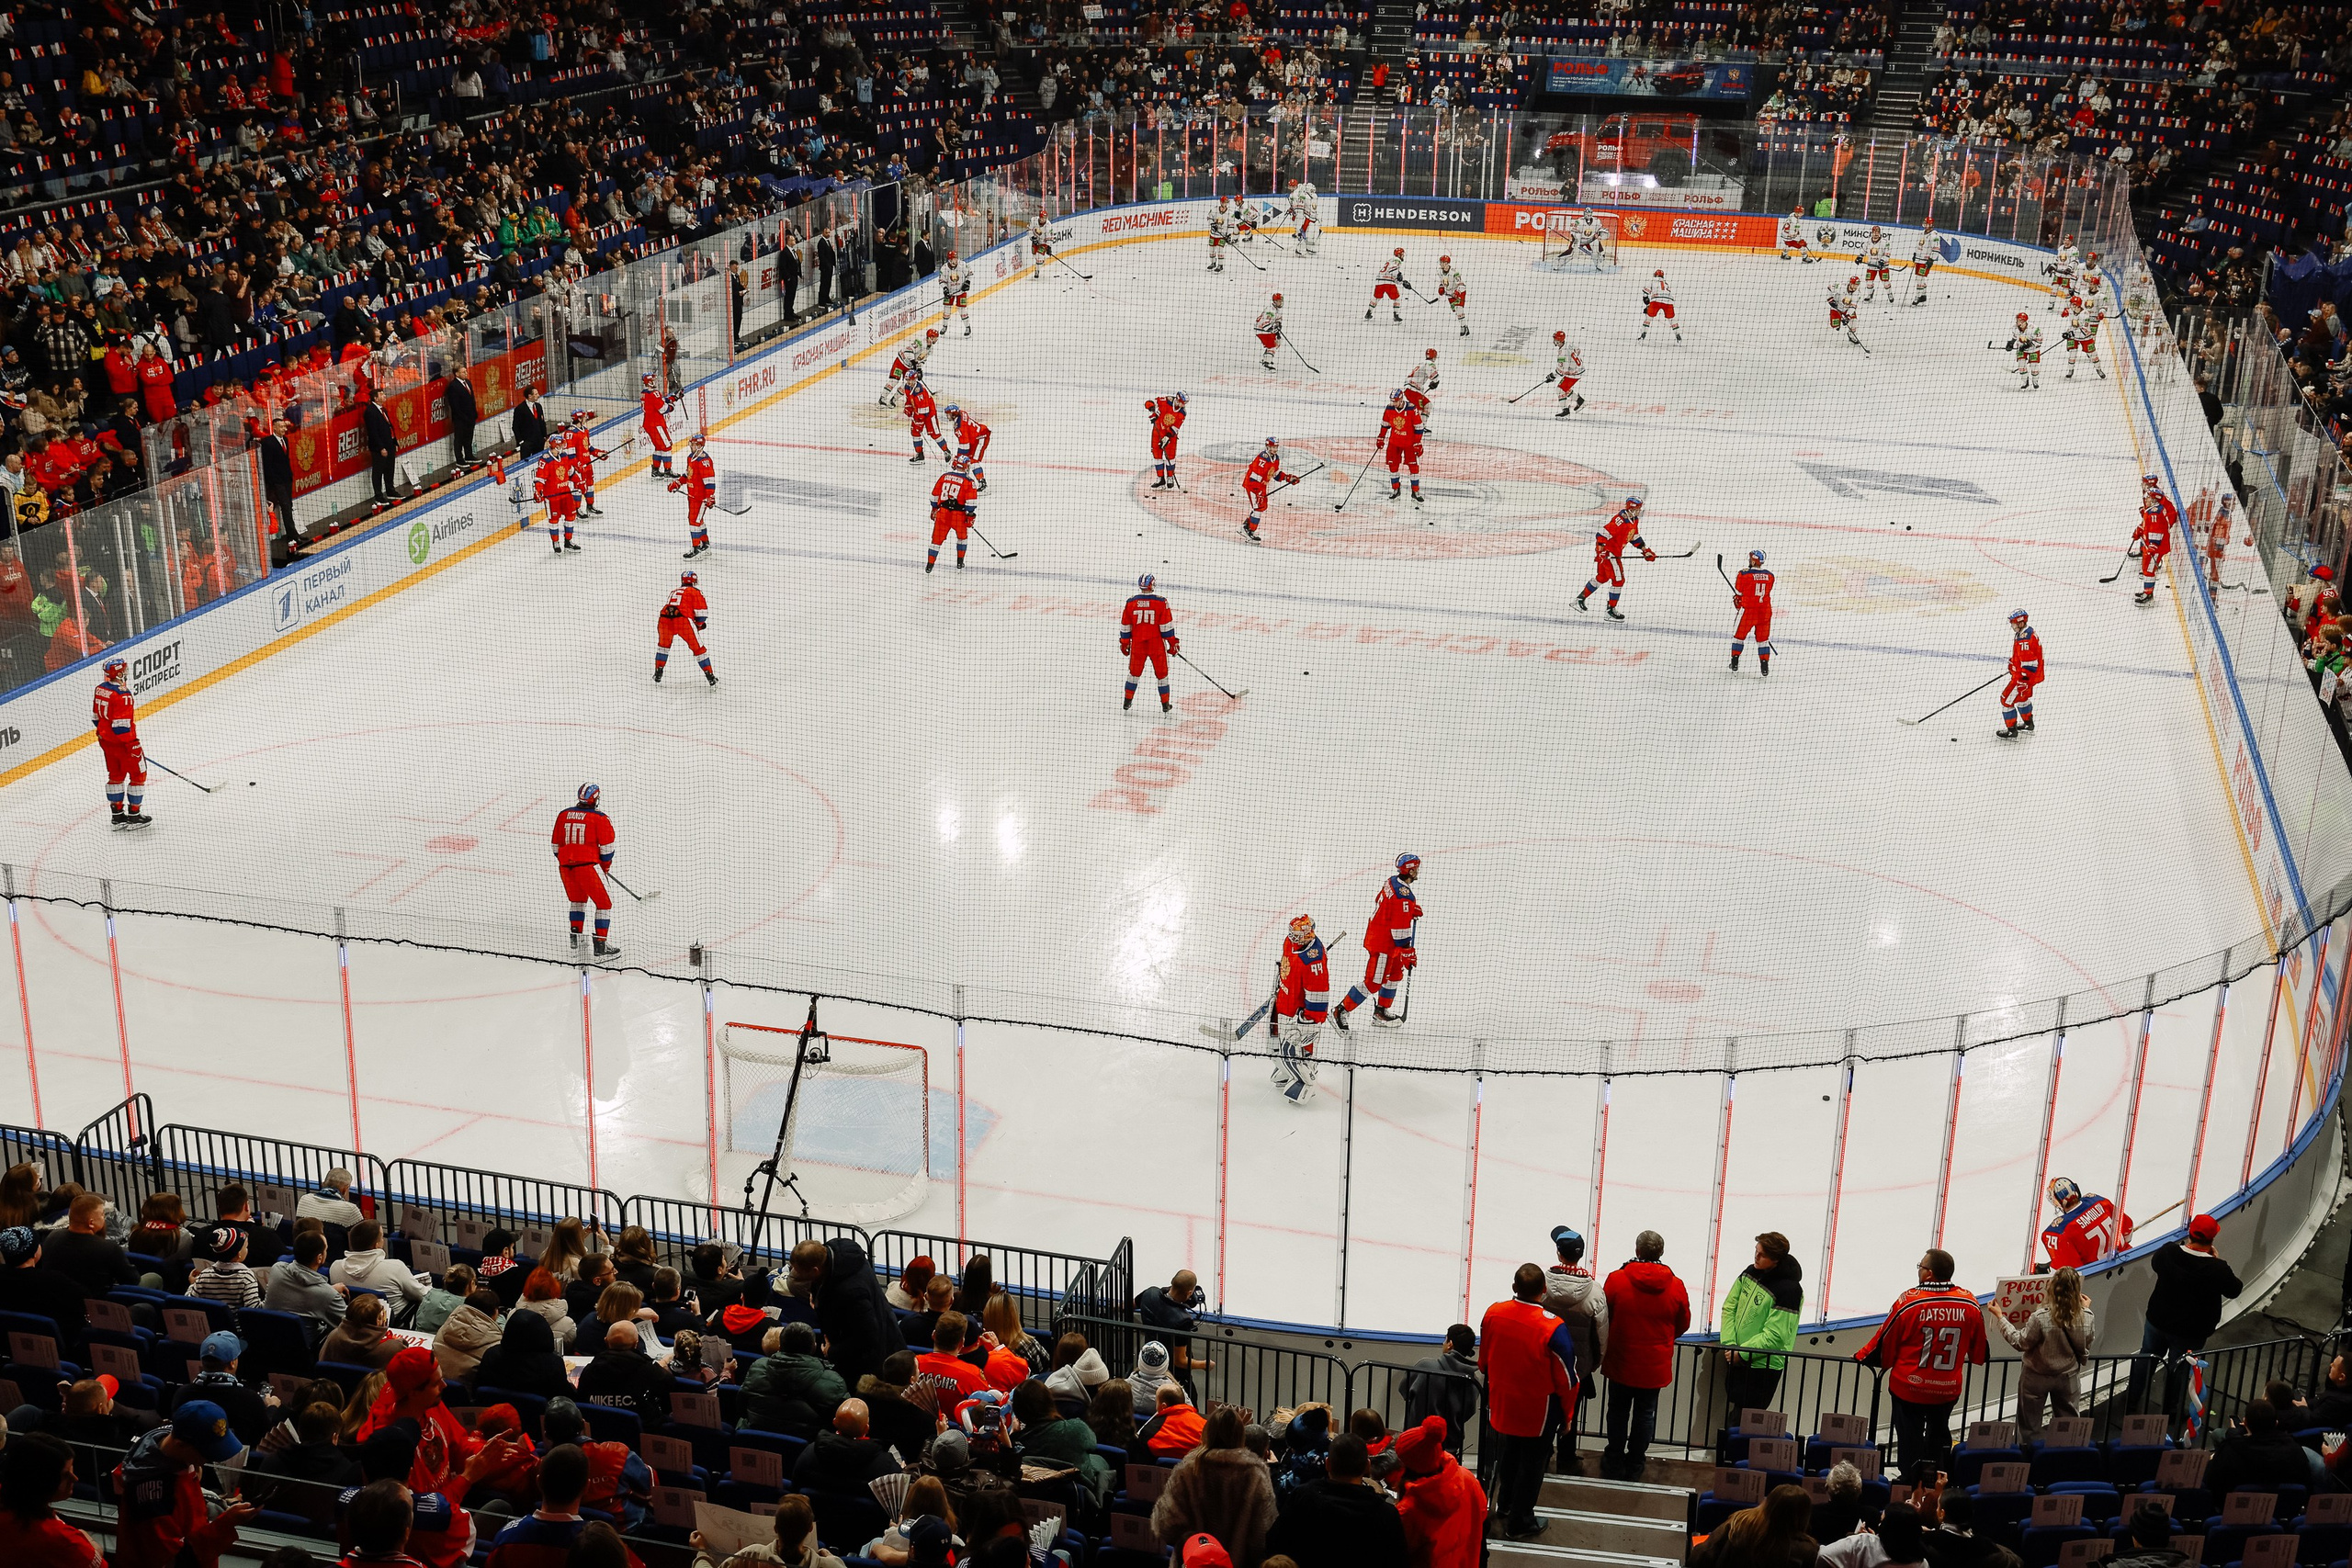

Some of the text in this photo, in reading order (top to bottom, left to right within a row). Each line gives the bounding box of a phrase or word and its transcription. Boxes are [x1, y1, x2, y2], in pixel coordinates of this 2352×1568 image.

[1553, 62, 1609, 75] РОЛЬФ
[1521, 186, 1560, 197] РОЛЬФ
[1601, 190, 1641, 200] РОЛЬФ
[1683, 194, 1724, 204] РОЛЬФ
[1102, 210, 1174, 233] RED MACHINE
[1374, 208, 1471, 222] HENDERSON
[1672, 219, 1715, 229] КРАСНАЯ
[1670, 228, 1713, 239] МАШИНА
[1967, 248, 2025, 268] НОРНИКЕЛЬ
[514, 359, 532, 381] RED
[738, 364, 776, 400] FHR.RU
[337, 427, 360, 450] RED
[940, 482, 961, 501] 89
[432, 513, 474, 544] Airlines
[303, 556, 352, 592] ПЕРВЫЙ
[305, 584, 345, 615] КАНАЛ
[1754, 583, 1766, 603] 4
[1133, 610, 1155, 625] 70
[132, 640, 181, 681] СПОРТ
[132, 663, 181, 696] ЭКСПРЕСС
[122, 695, 133, 706] 77
[566, 811, 587, 820] IVANOV
[564, 822, 586, 845] 10
[2075, 1202, 2106, 1229] SAMOILOV
[1919, 1308, 1966, 1322] DATSYUK
[1918, 1326, 1962, 1371] 13
[589, 1394, 637, 1406] NIKE F.C.
